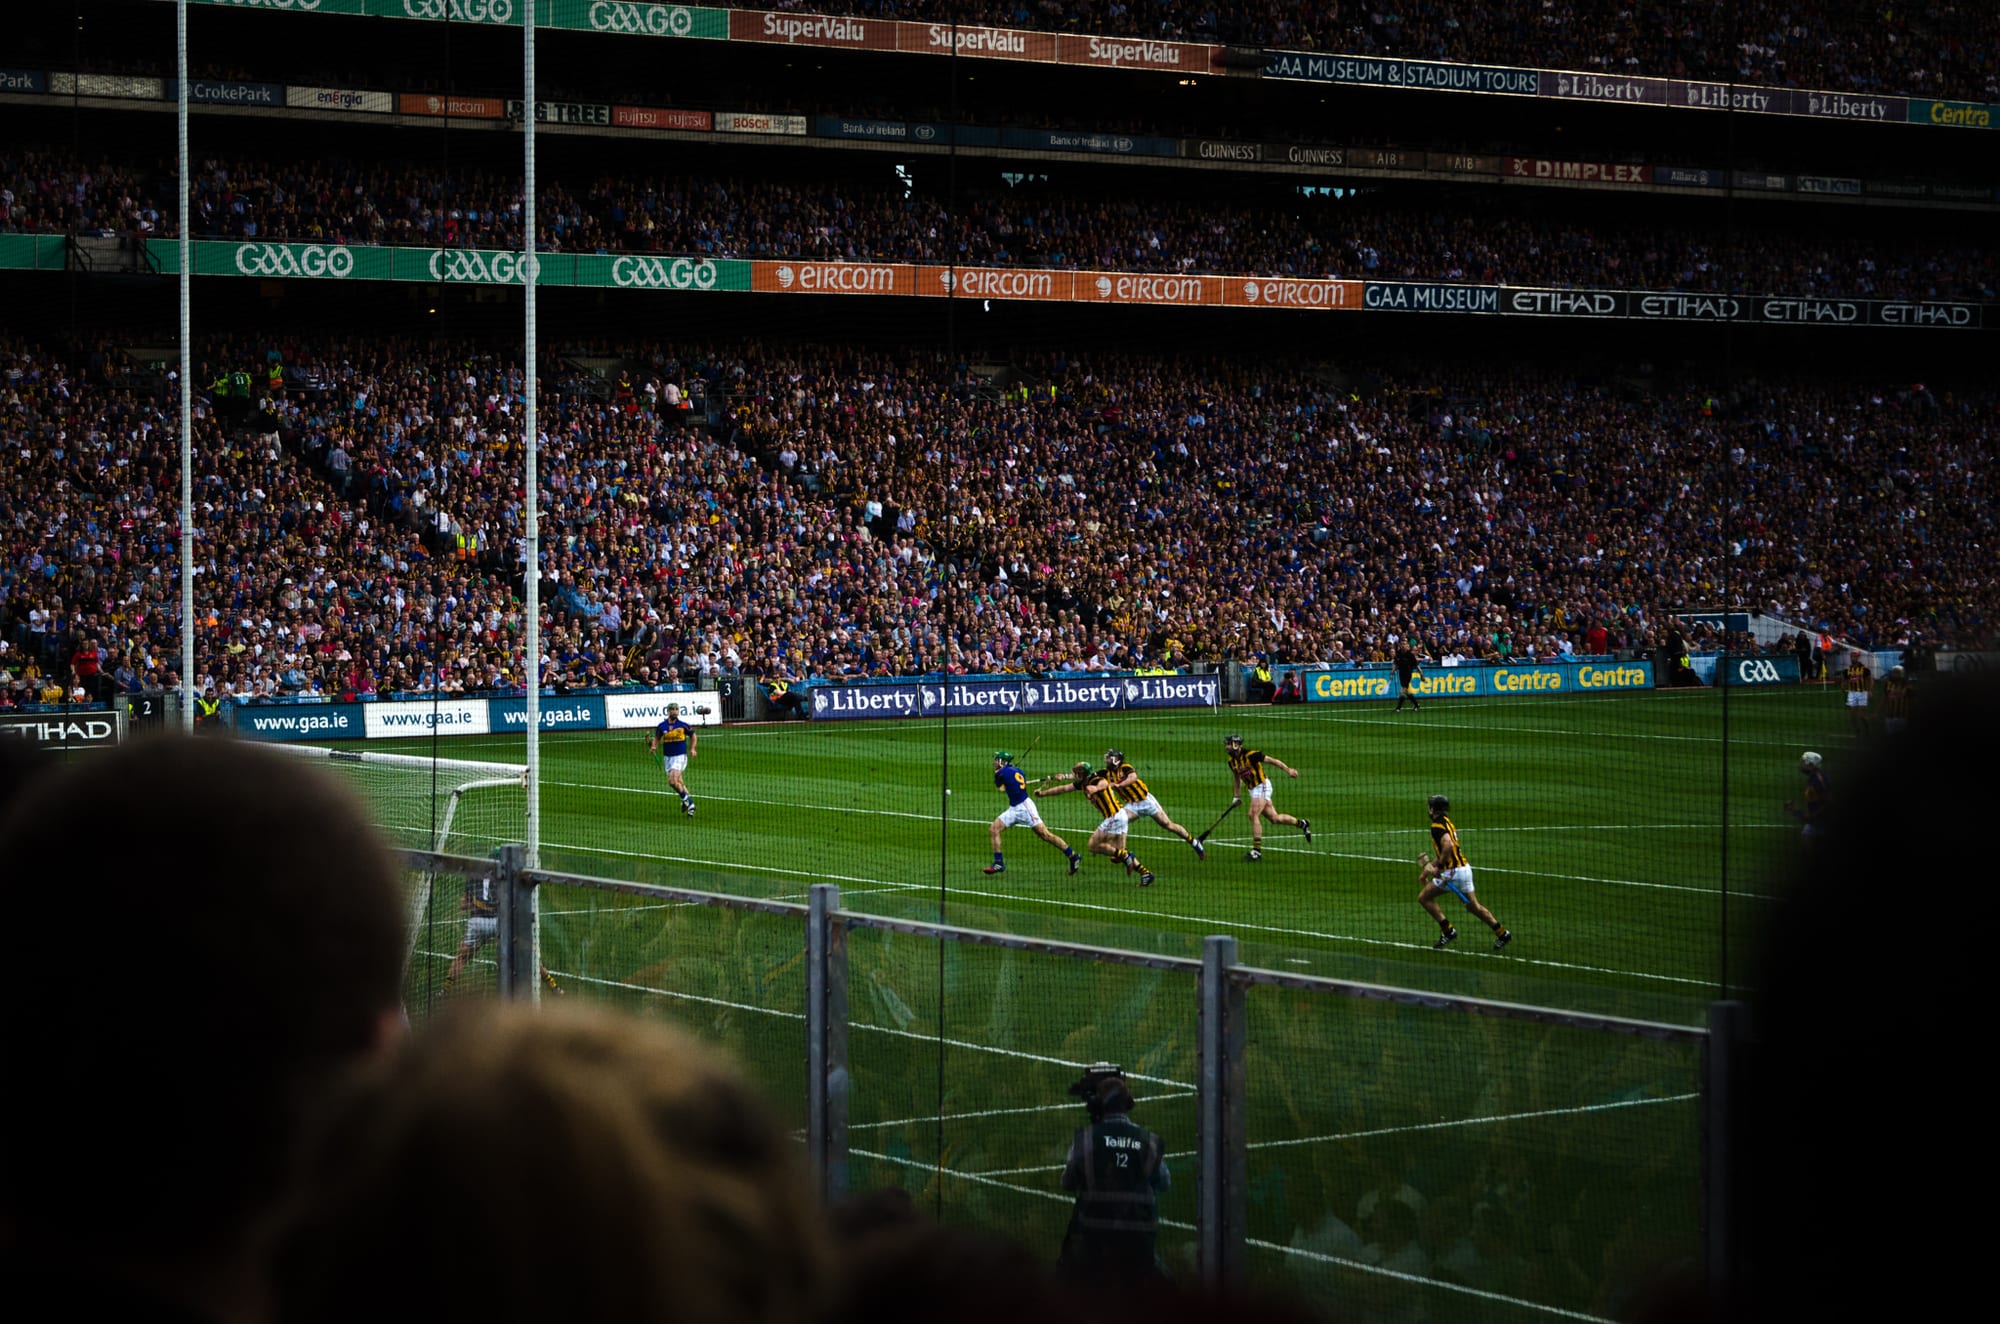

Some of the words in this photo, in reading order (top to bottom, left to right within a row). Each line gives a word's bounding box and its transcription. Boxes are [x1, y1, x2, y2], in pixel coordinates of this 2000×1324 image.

[763, 14, 865, 43] SuperValu
[929, 26, 1025, 55] SuperValu
[1088, 38, 1180, 65] SuperValu
[1308, 58, 1382, 81] MUSEUM
[1387, 66, 1401, 82] &
[1406, 66, 1480, 89] STADIUM
[1484, 71, 1537, 92] TOURS
[194, 83, 271, 101] CrokePark
[1571, 75, 1645, 102] Liberty
[1700, 86, 1770, 113] Liberty
[554, 104, 608, 124] TREE
[1821, 93, 1888, 120] Liberty
[1930, 103, 1990, 126] Centra
[619, 112, 657, 125] FUJITSU
[668, 114, 706, 127] FUJITSU
[733, 118, 769, 129] BOSCH
[842, 123, 865, 134] Bank
[866, 124, 875, 134] of
[876, 124, 906, 136] Ireland
[1050, 136, 1070, 145] Bank
[1200, 141, 1255, 160] GUINNESS
[1289, 146, 1342, 165] GUINNESS
[1535, 160, 1643, 183] DIMPLEX
[1365, 286, 1408, 307] GAA
[1413, 288, 1497, 311] MUSEUM
[1512, 292, 1616, 314] ETIHAD
[1641, 296, 1739, 317] ETIHAD
[1763, 301, 1857, 321] ETIHAD
[1880, 304, 1970, 325] ETIHAD
[1493, 669, 1561, 691] Centra
[1579, 666, 1645, 688] Centra
[1739, 660, 1781, 682] GAA
[724, 682, 732, 696] 3
[1315, 674, 1388, 697] Centra
[1408, 672, 1476, 694] Centra
[832, 689, 915, 715] Liberty
[939, 686, 1019, 711] Liberty
[1042, 682, 1121, 708] Liberty
[143, 701, 152, 715] 2
[382, 709, 472, 728] www.gaa.ie
[503, 705, 591, 727] ww.gaa.ie
[254, 712, 348, 733] www.gaa.ie
[1014, 772, 1026, 790] 9
[1115, 1152, 1128, 1168] 12
